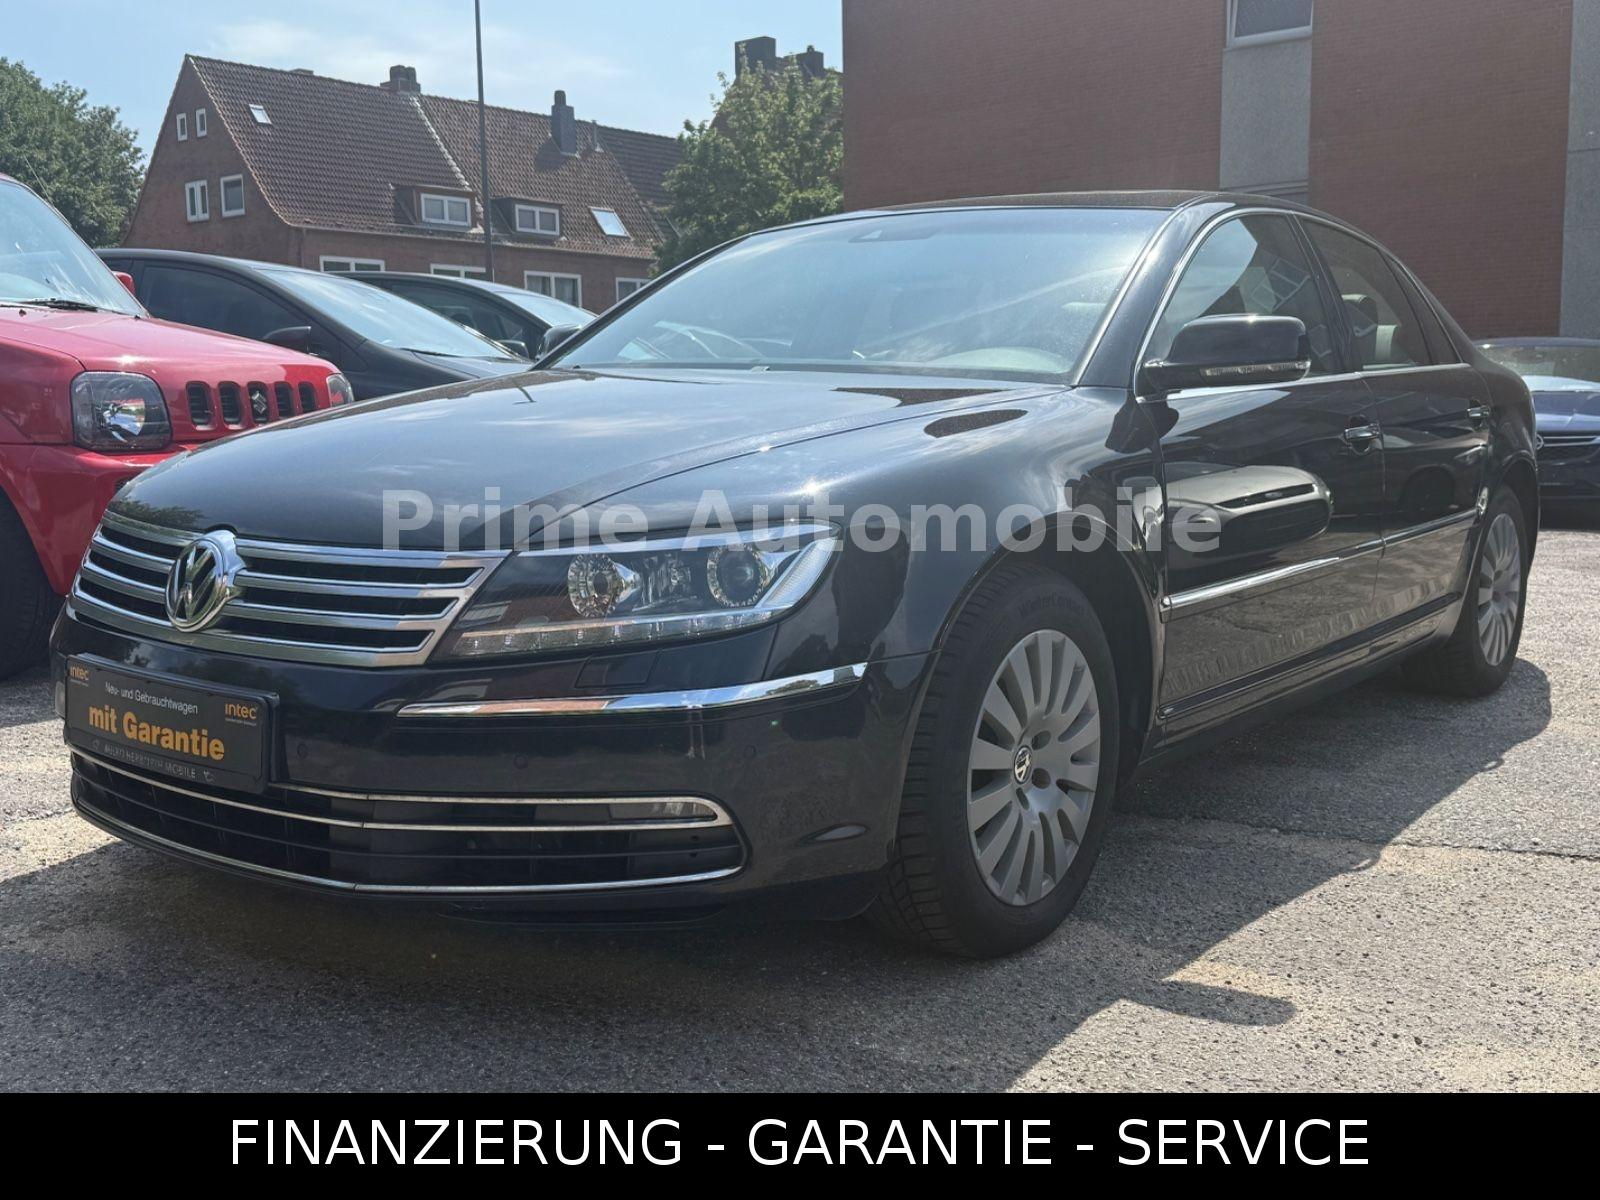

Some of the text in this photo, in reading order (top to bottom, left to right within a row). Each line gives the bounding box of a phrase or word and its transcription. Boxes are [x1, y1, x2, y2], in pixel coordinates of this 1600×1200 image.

[120, 687, 134, 700] und
[134, 689, 199, 716] Gebrauchtwagen
[225, 702, 257, 720] intec
[88, 704, 118, 734] mit
[122, 710, 225, 761] Garantie
